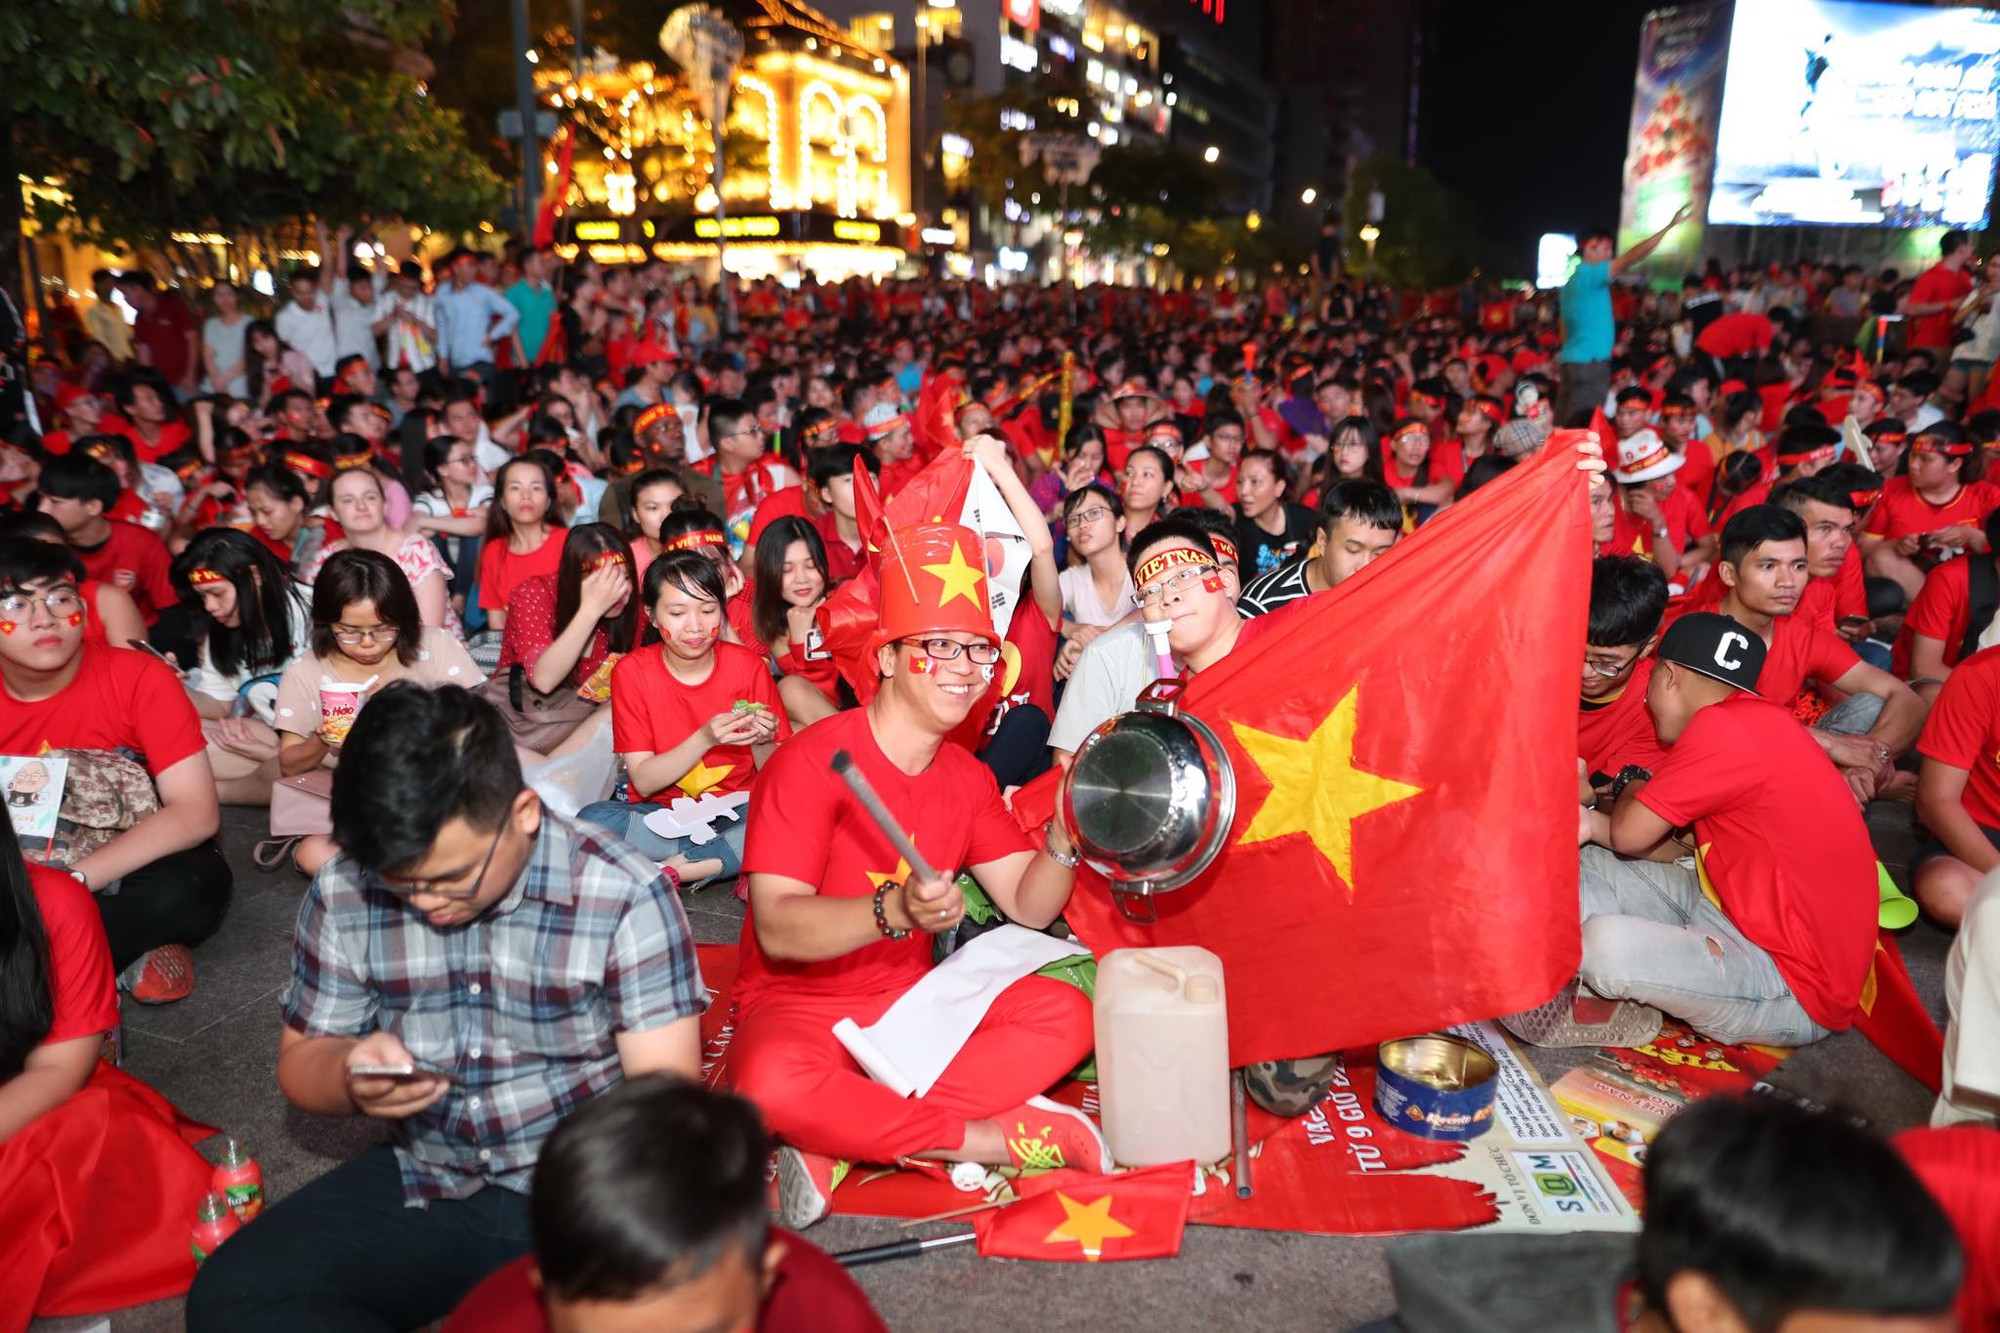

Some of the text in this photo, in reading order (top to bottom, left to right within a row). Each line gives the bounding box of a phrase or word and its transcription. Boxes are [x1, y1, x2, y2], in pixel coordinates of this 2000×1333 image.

[1714, 631, 1749, 671] C
[1326, 1090, 1366, 1121] GIỜ
[1346, 1125, 1374, 1139] 9
[1346, 1141, 1388, 1173] TỪ
[1527, 1154, 1585, 1213] SQM
